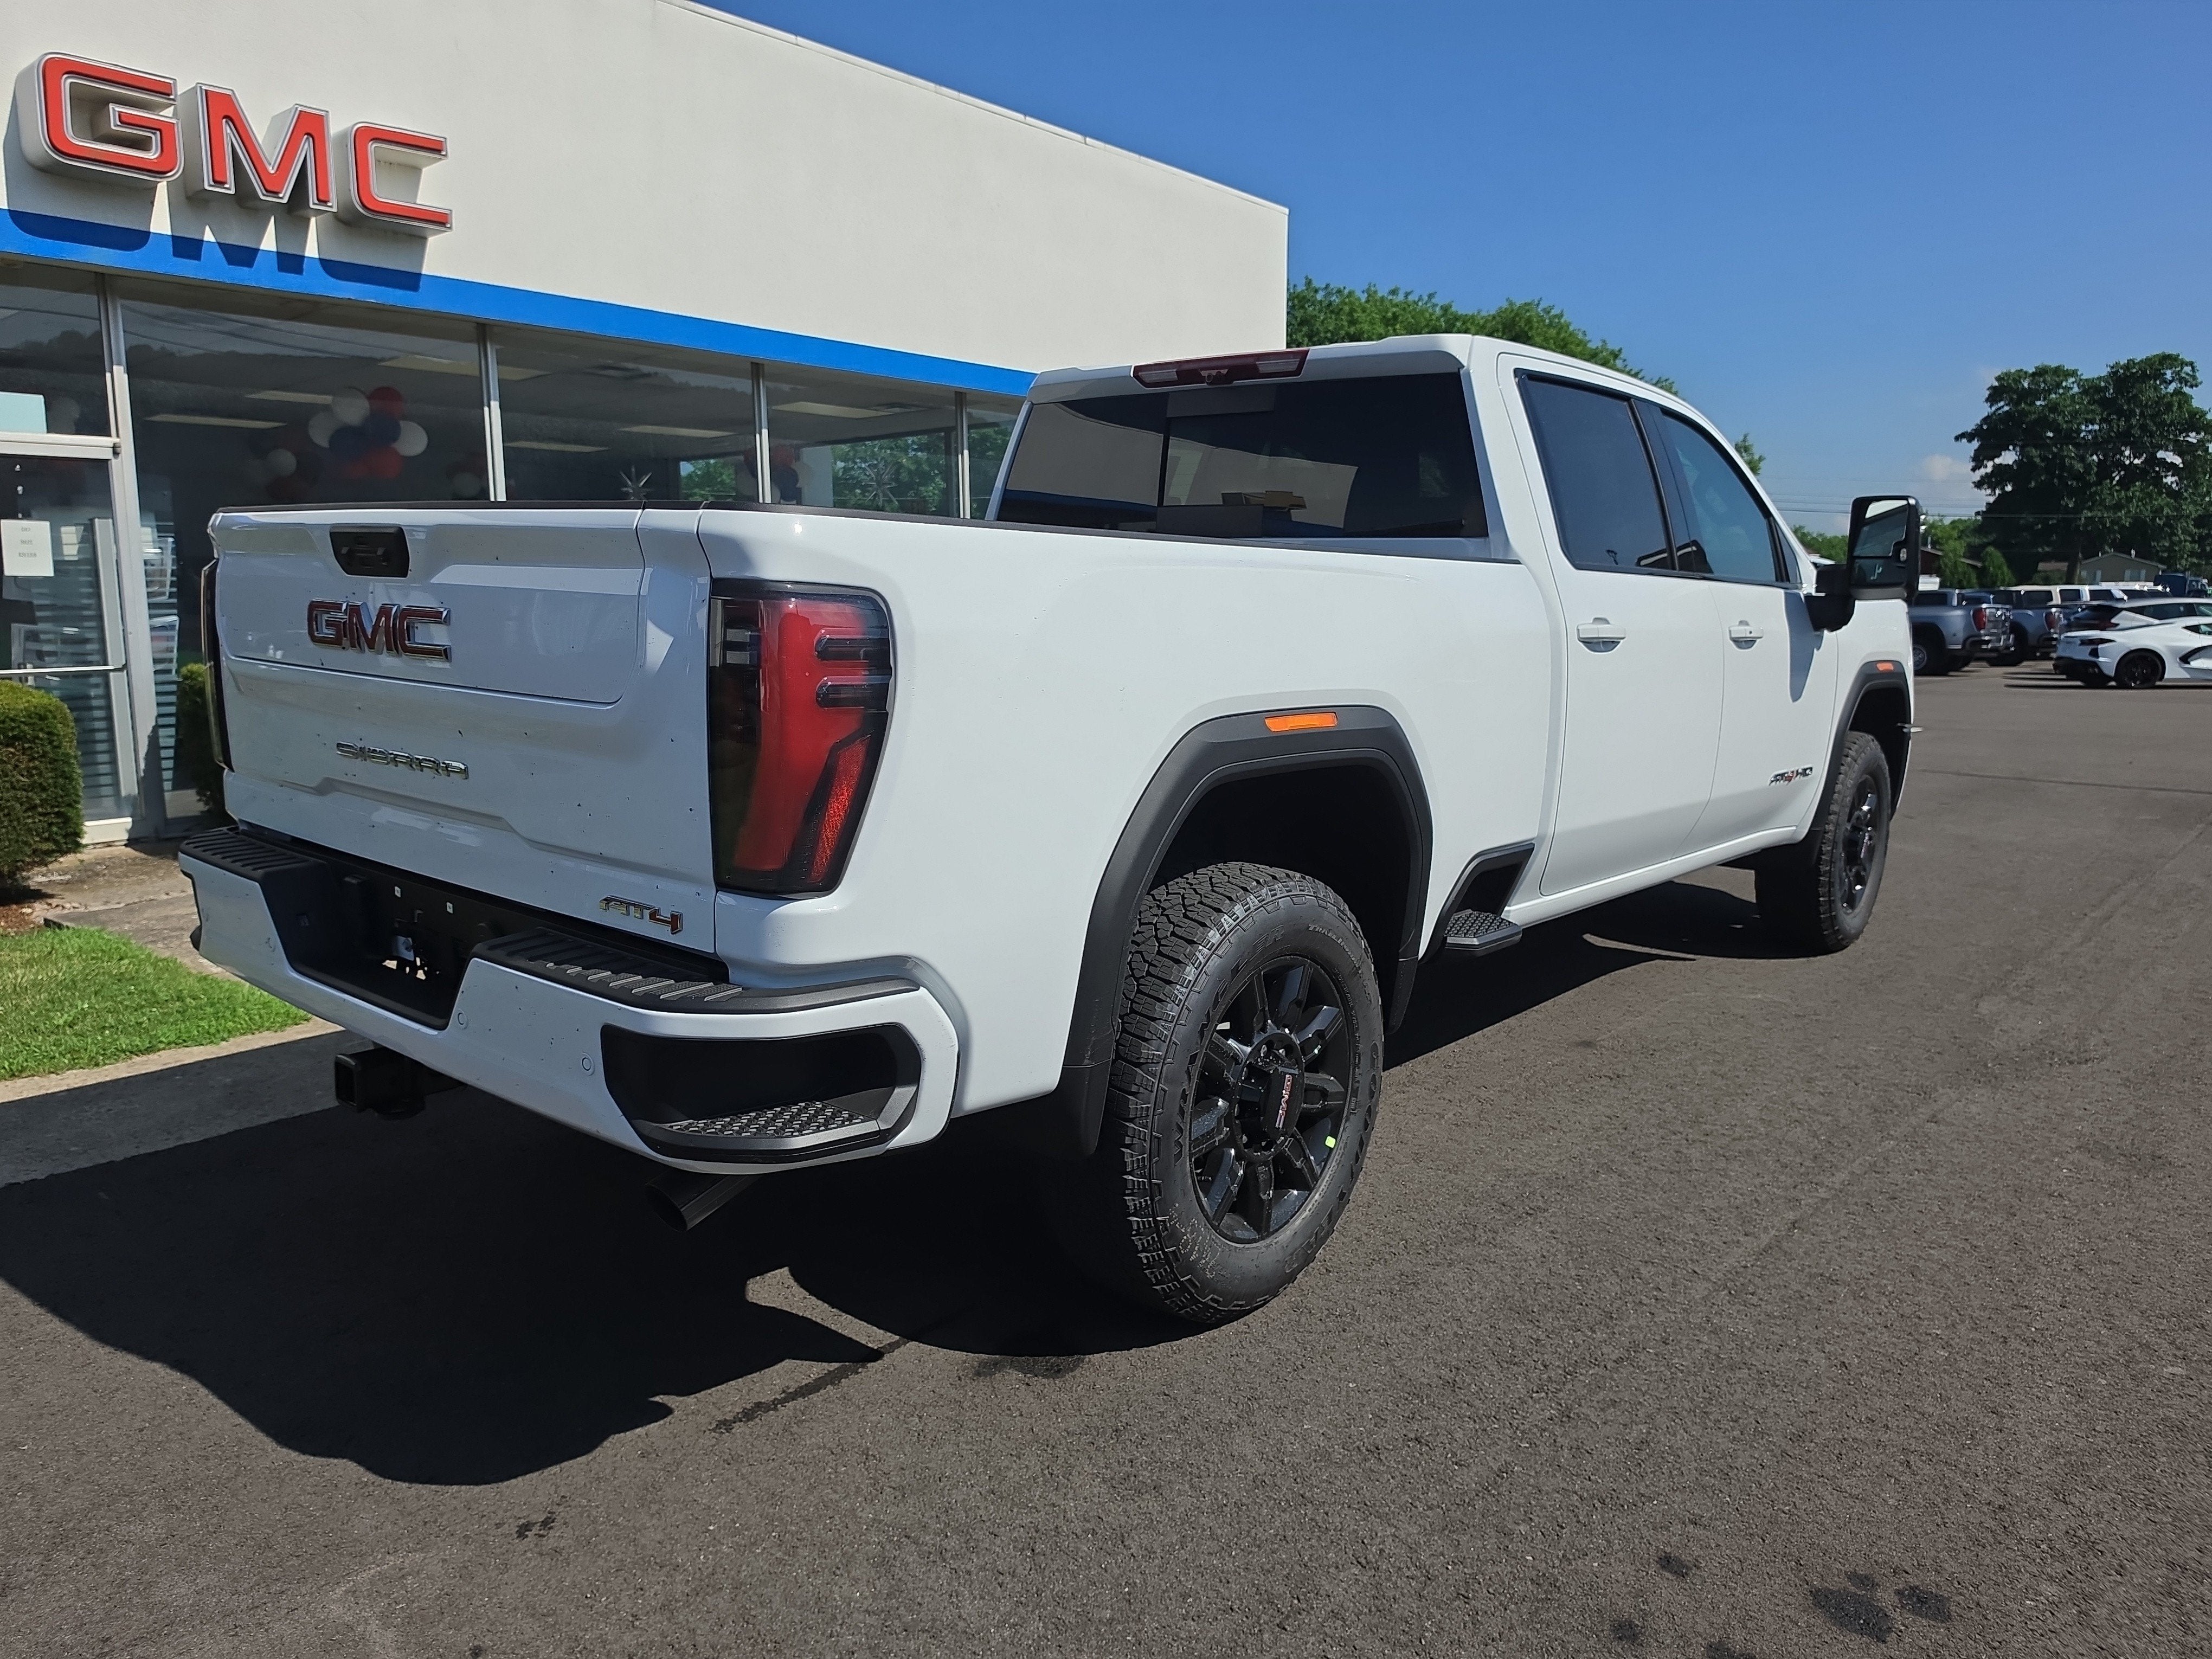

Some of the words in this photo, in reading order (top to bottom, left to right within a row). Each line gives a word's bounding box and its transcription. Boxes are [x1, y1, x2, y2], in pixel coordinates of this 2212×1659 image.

[36, 51, 453, 232] GMC
[307, 598, 452, 662] GMC
[336, 741, 469, 780] SIERRA
[599, 895, 683, 935] AT4
[1174, 924, 1284, 1166] WRANGLER
[1275, 1074, 1293, 1129] GMC
